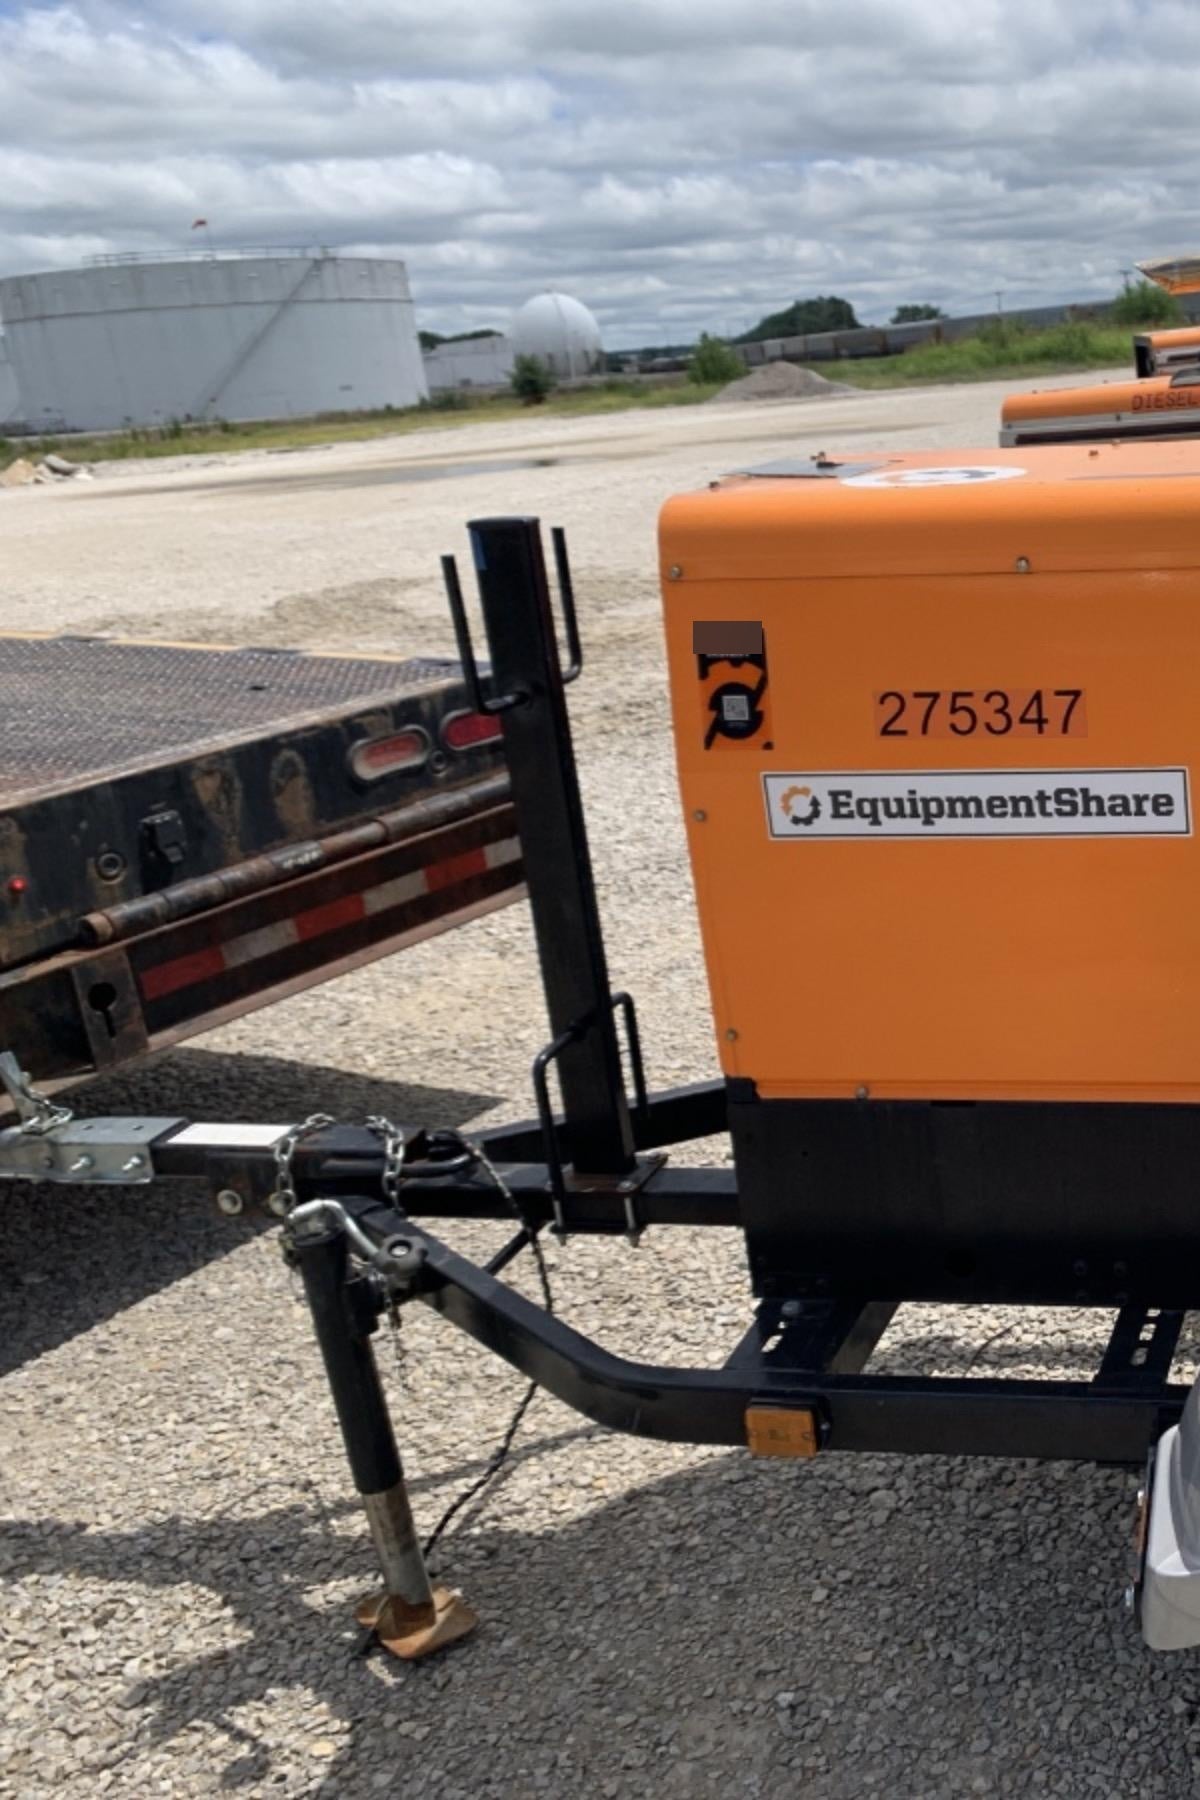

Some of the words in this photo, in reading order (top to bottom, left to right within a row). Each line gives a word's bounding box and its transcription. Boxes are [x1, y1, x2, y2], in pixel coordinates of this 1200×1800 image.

[1132, 390, 1198, 411] DIESEL
[879, 689, 1083, 736] 275347
[828, 786, 1175, 827] EquipmentShare
